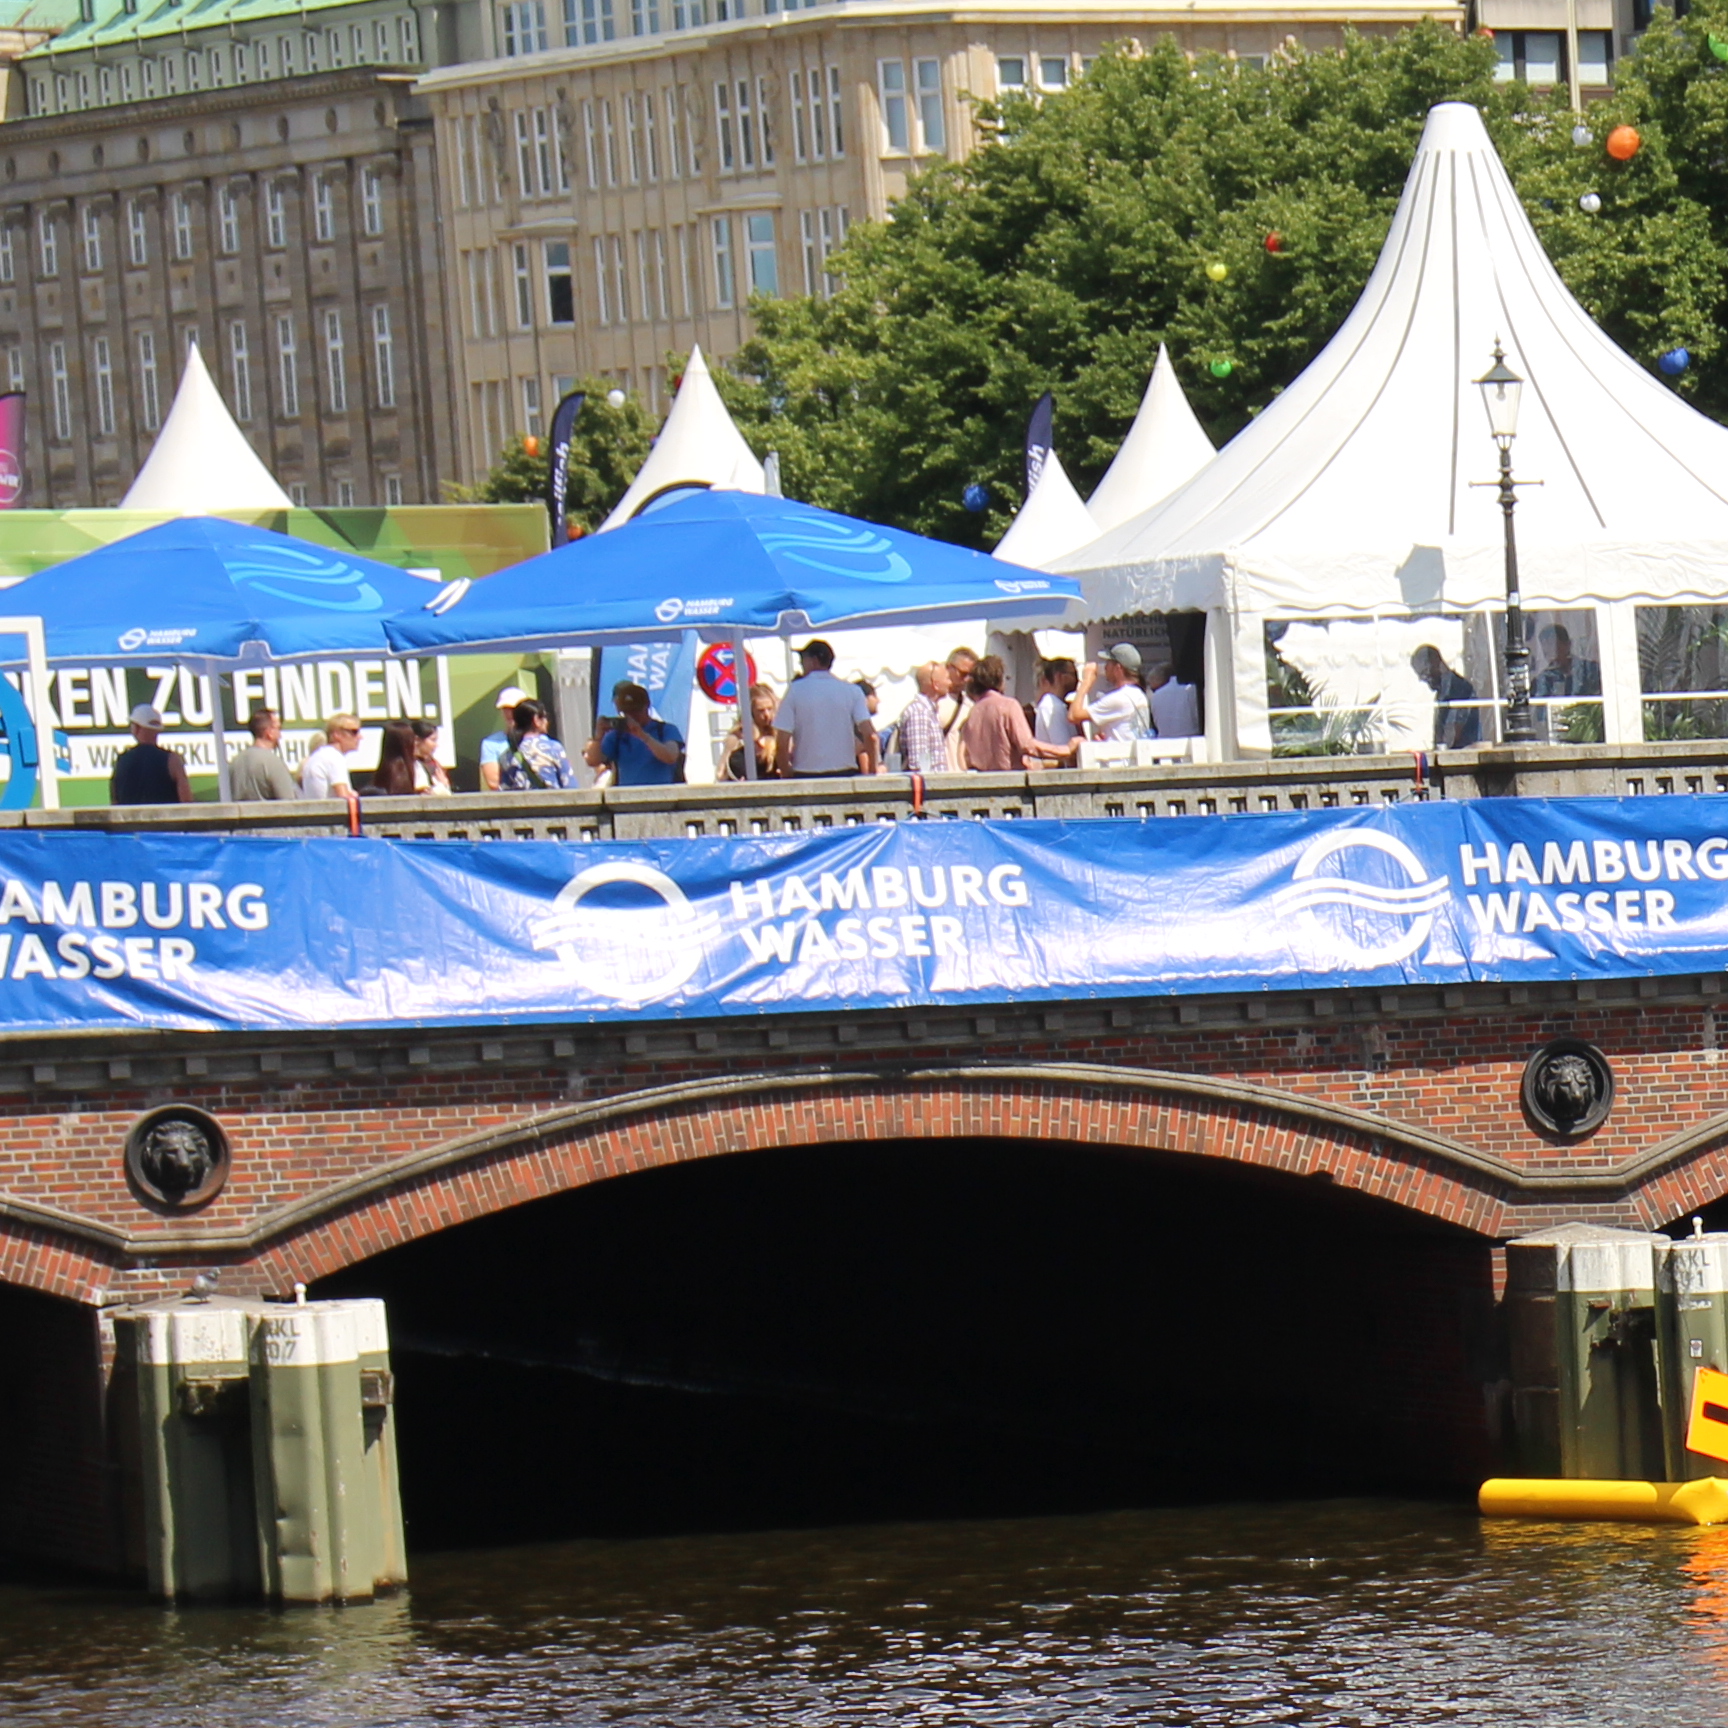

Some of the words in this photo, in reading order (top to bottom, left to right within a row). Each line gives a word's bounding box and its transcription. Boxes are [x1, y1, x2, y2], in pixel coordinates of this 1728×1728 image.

[146, 664, 213, 726] ZU
[232, 657, 438, 723] FINDEN.
[0, 880, 270, 930] AMBURG
[731, 864, 1028, 918] HAMBURG
[1466, 889, 1677, 935] WASSER
[742, 915, 968, 964] WASSER
[267, 1340, 298, 1361] 07
